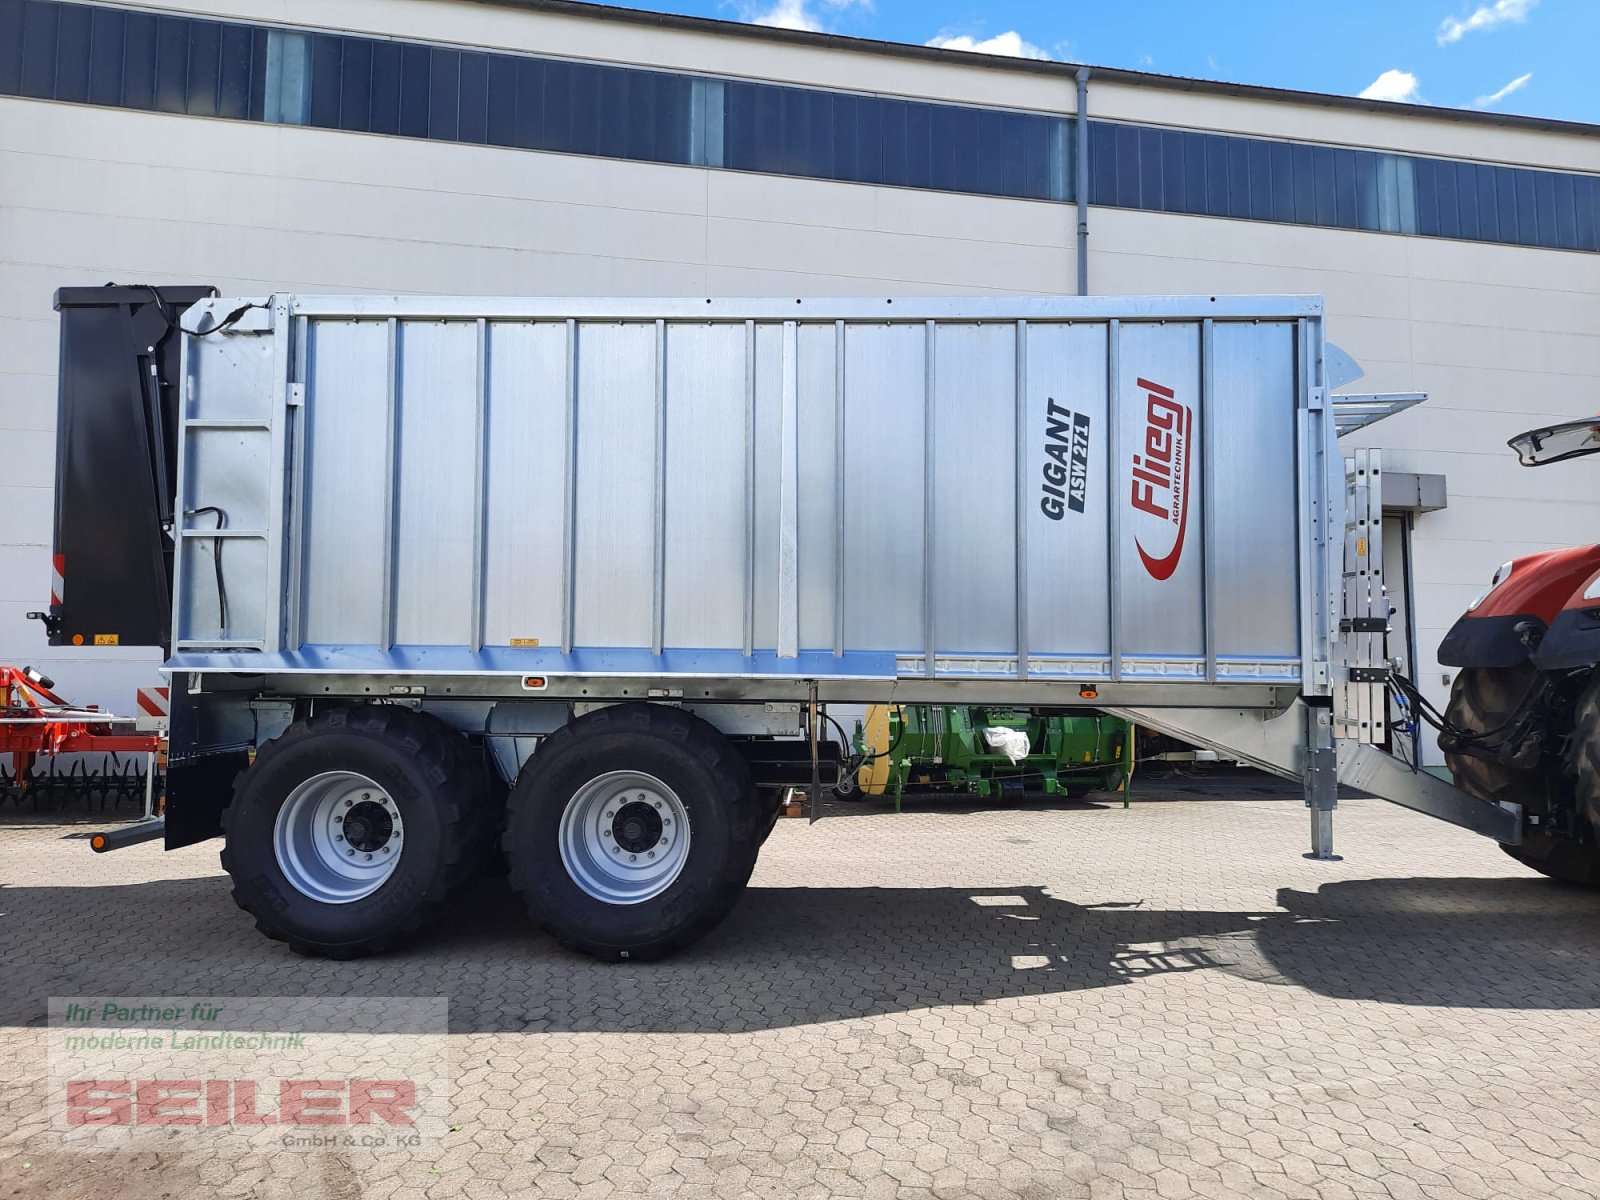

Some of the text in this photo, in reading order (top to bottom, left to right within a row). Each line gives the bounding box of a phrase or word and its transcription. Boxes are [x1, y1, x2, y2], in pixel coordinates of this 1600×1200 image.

[1040, 397, 1071, 521] GIGANT
[1071, 424, 1089, 502] ASW 271
[1131, 377, 1184, 520] Fliegl
[1172, 437, 1183, 525] AGRARTECHNIK
